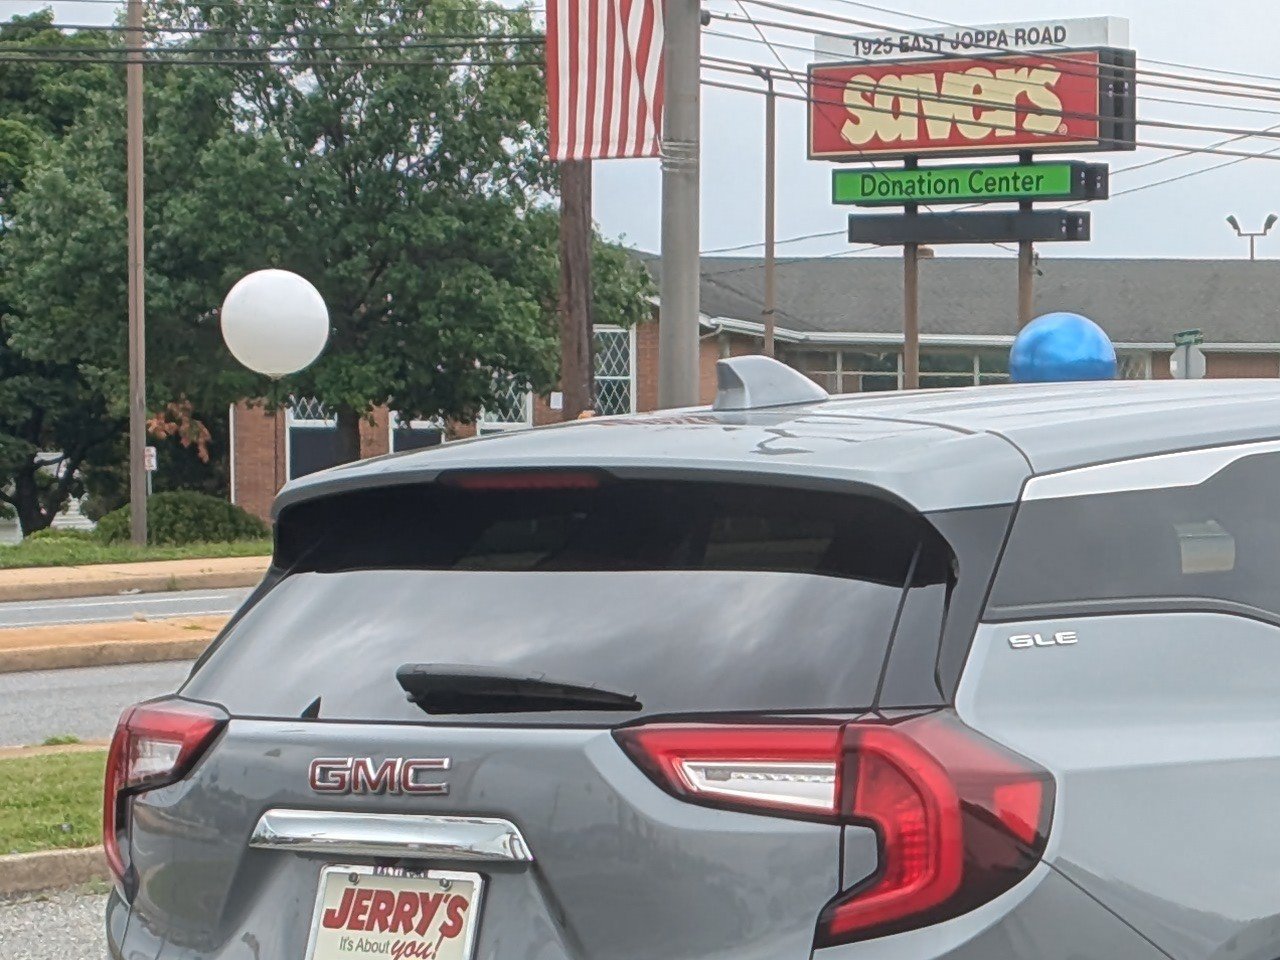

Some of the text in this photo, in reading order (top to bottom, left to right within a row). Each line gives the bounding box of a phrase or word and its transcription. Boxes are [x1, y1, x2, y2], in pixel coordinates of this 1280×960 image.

[852, 25, 1067, 56] 1925 EAST JOPPA ROAD
[860, 169, 1045, 197] Donation Center
[1008, 631, 1079, 649] SLE
[308, 757, 451, 795] GMC
[322, 887, 469, 939] JERRY'S
[339, 936, 354, 951] It's
[354, 937, 391, 954] About
